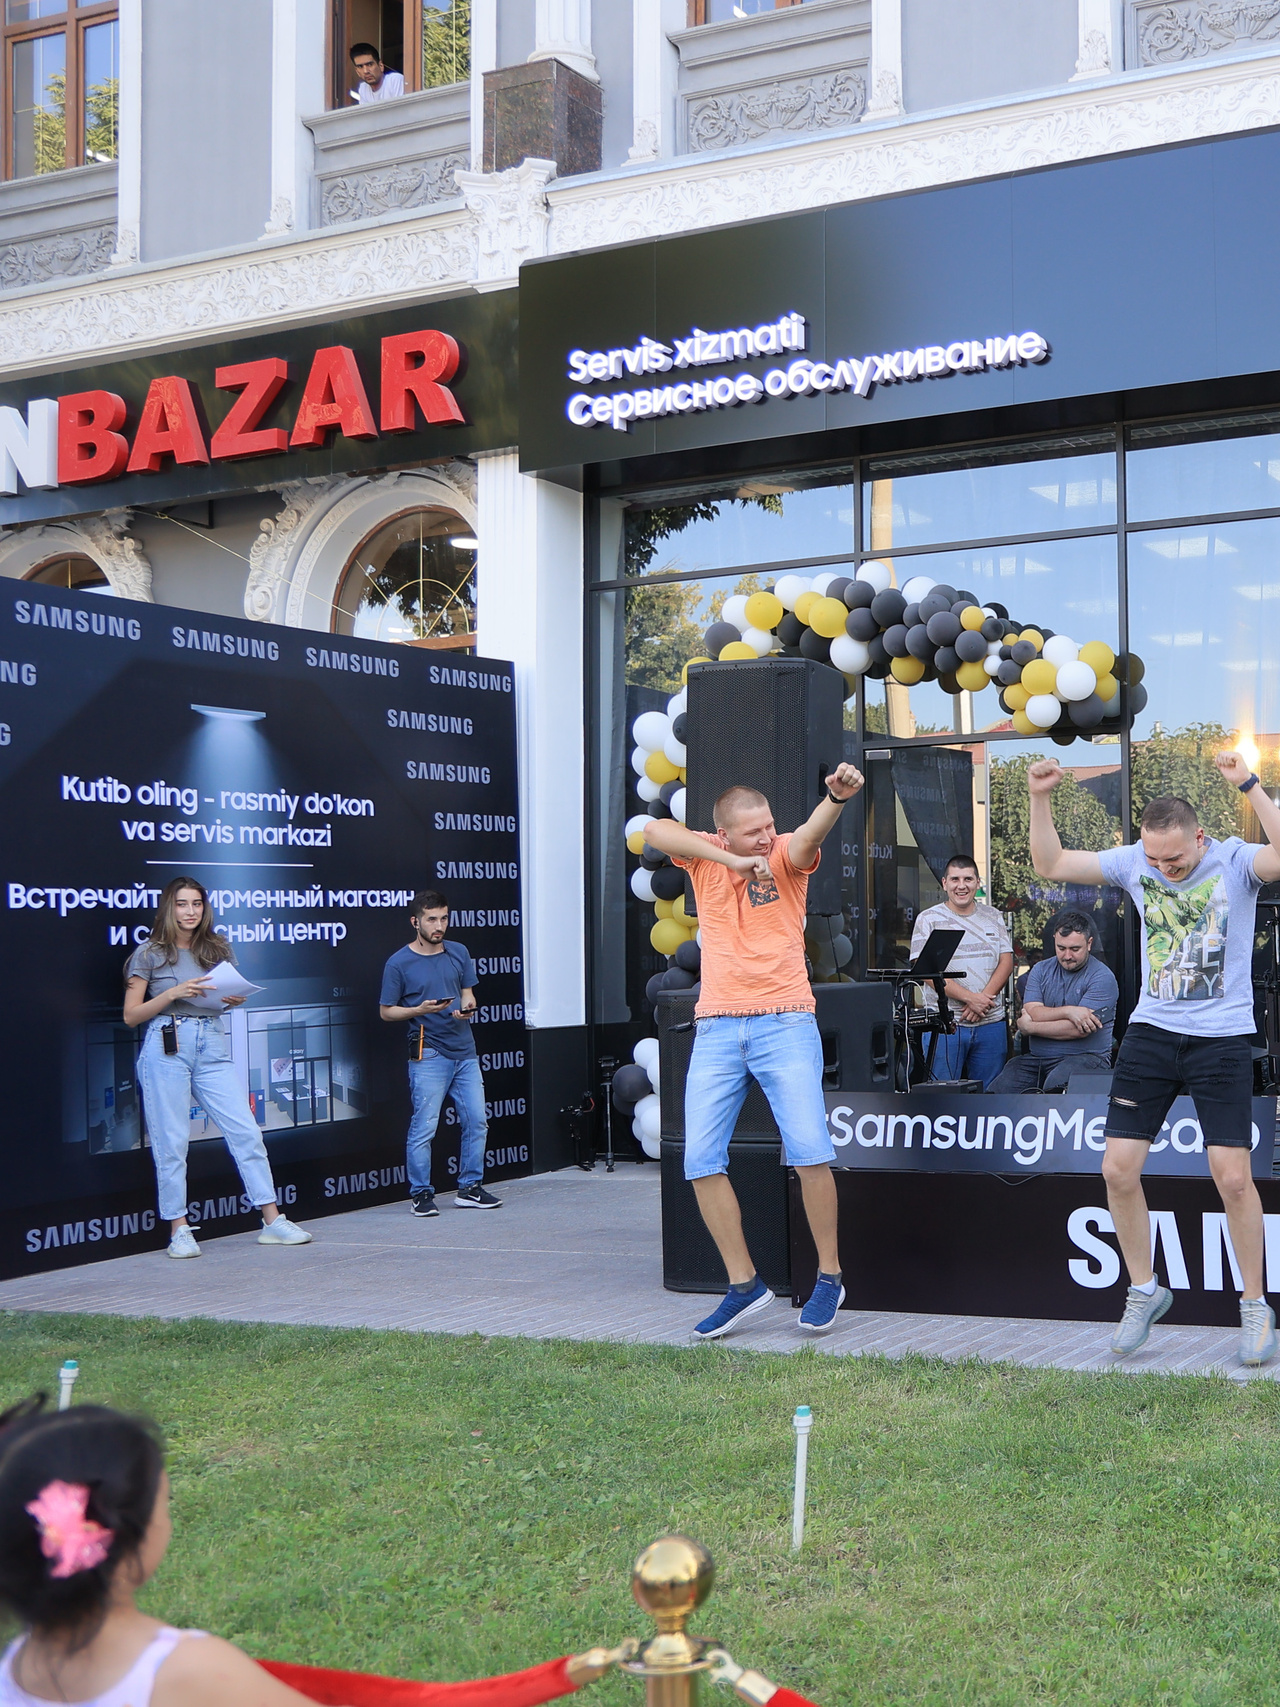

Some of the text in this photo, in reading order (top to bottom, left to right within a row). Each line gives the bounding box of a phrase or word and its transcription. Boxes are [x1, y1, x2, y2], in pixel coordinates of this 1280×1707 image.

[568, 311, 806, 384] Servis xizmati
[567, 329, 1048, 432] Сервисное обслуживание
[15, 600, 142, 641] SAMSUNG
[173, 626, 279, 661] SAMSUNG
[306, 647, 400, 678] SAMSUNG
[429, 665, 512, 693] SAMSUNG
[387, 708, 473, 736] SAMSUNG
[406, 760, 491, 785] SAMSUNG
[62, 775, 131, 804] Kutib
[137, 780, 198, 815] oling
[220, 788, 299, 819] rasmiy
[122, 819, 332, 847] va servis markazi
[434, 811, 516, 833] SAMSUNG
[436, 860, 518, 882] SAMSUNG
[8, 883, 163, 917] Встречайт
[206, 884, 323, 915] ирменный
[449, 909, 520, 928] AMSUNG
[110, 925, 127, 946] и
[280, 922, 347, 947] центр
[471, 956, 521, 976] SUNG
[477, 1050, 525, 1072] SUNG
[445, 1097, 526, 1126] SSUNG
[447, 1144, 529, 1175] SSUNG
[324, 1165, 405, 1198] SAMSUN
[188, 1184, 297, 1223] SAMSNG
[26, 1211, 156, 1253] SAMSUNG
